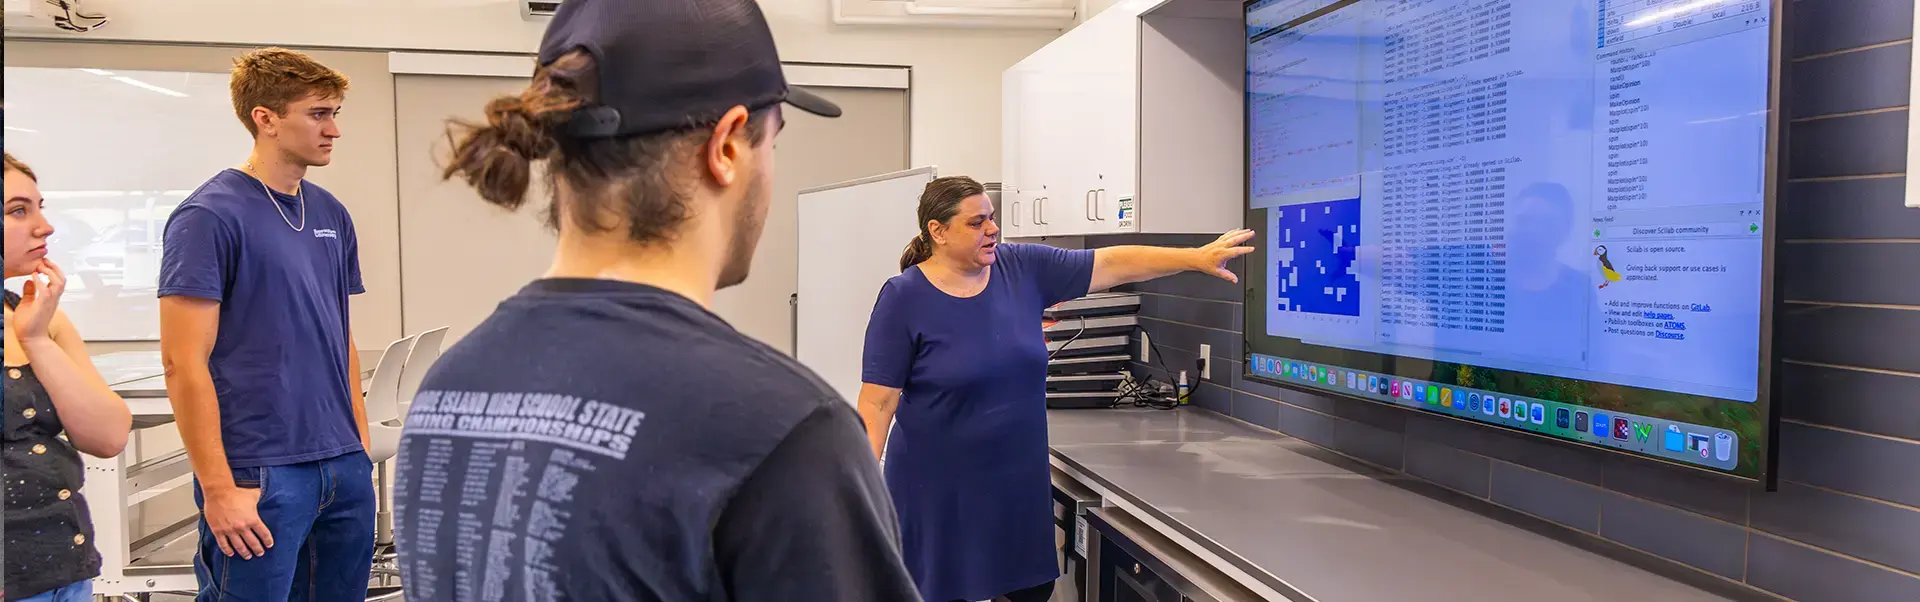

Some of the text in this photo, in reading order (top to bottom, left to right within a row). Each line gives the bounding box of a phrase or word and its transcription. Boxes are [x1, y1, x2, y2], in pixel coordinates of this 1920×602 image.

[1633, 227, 1656, 235] Discover
[1676, 226, 1709, 234] community
[438, 390, 490, 414] ISLAND
[518, 392, 582, 421] SCHOOL
[578, 400, 645, 436] STATE
[458, 415, 632, 452] CHAMPIONSHIPS
